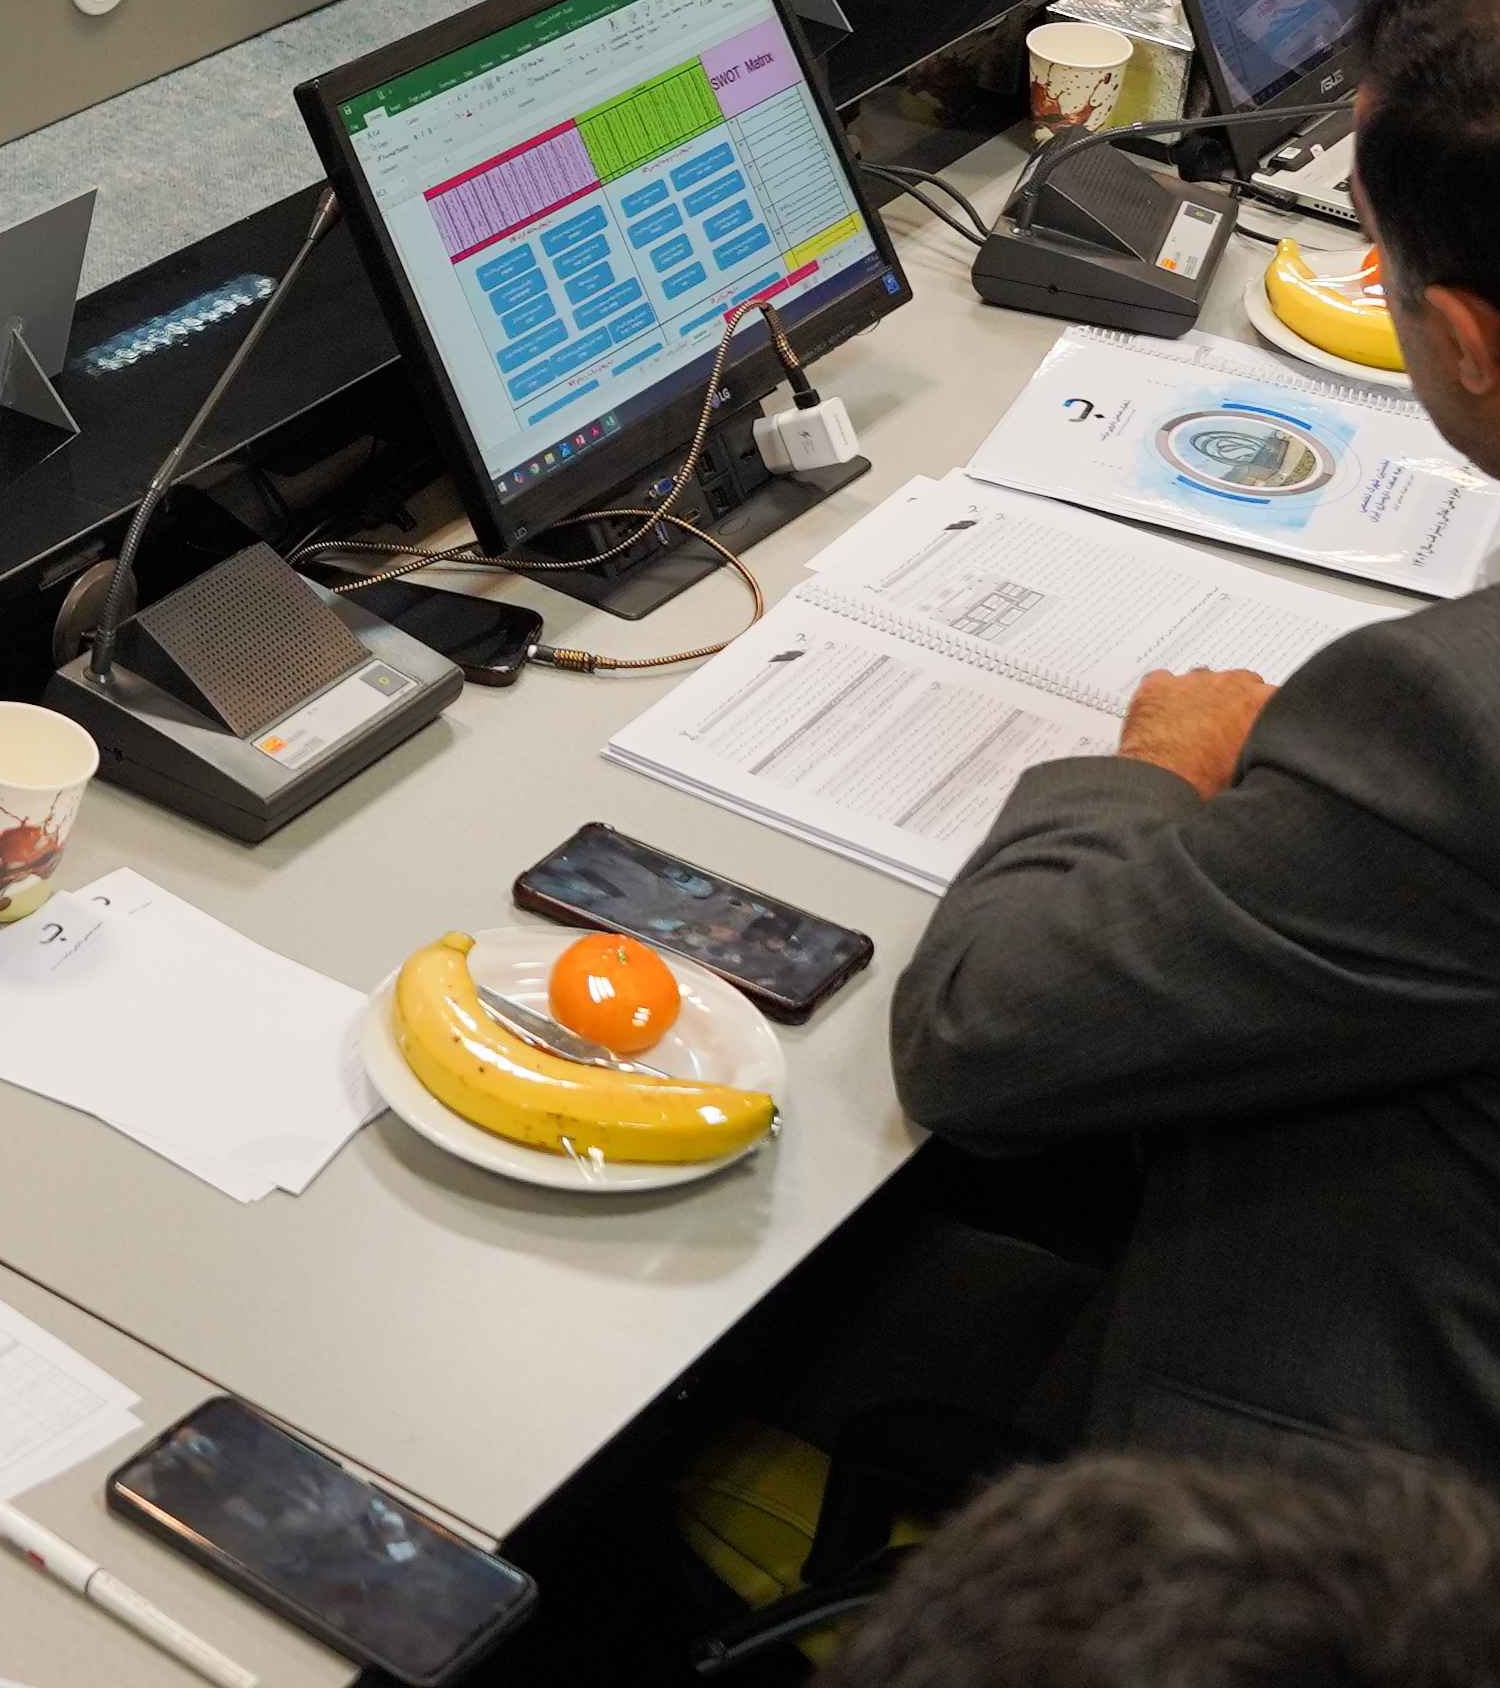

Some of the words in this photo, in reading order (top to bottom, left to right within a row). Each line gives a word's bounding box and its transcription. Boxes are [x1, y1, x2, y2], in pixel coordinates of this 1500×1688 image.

[710, 66, 741, 91] SWOT
[747, 50, 774, 74] Matrix
[1320, 69, 1345, 94] ASUS
[719, 387, 731, 402] LG
